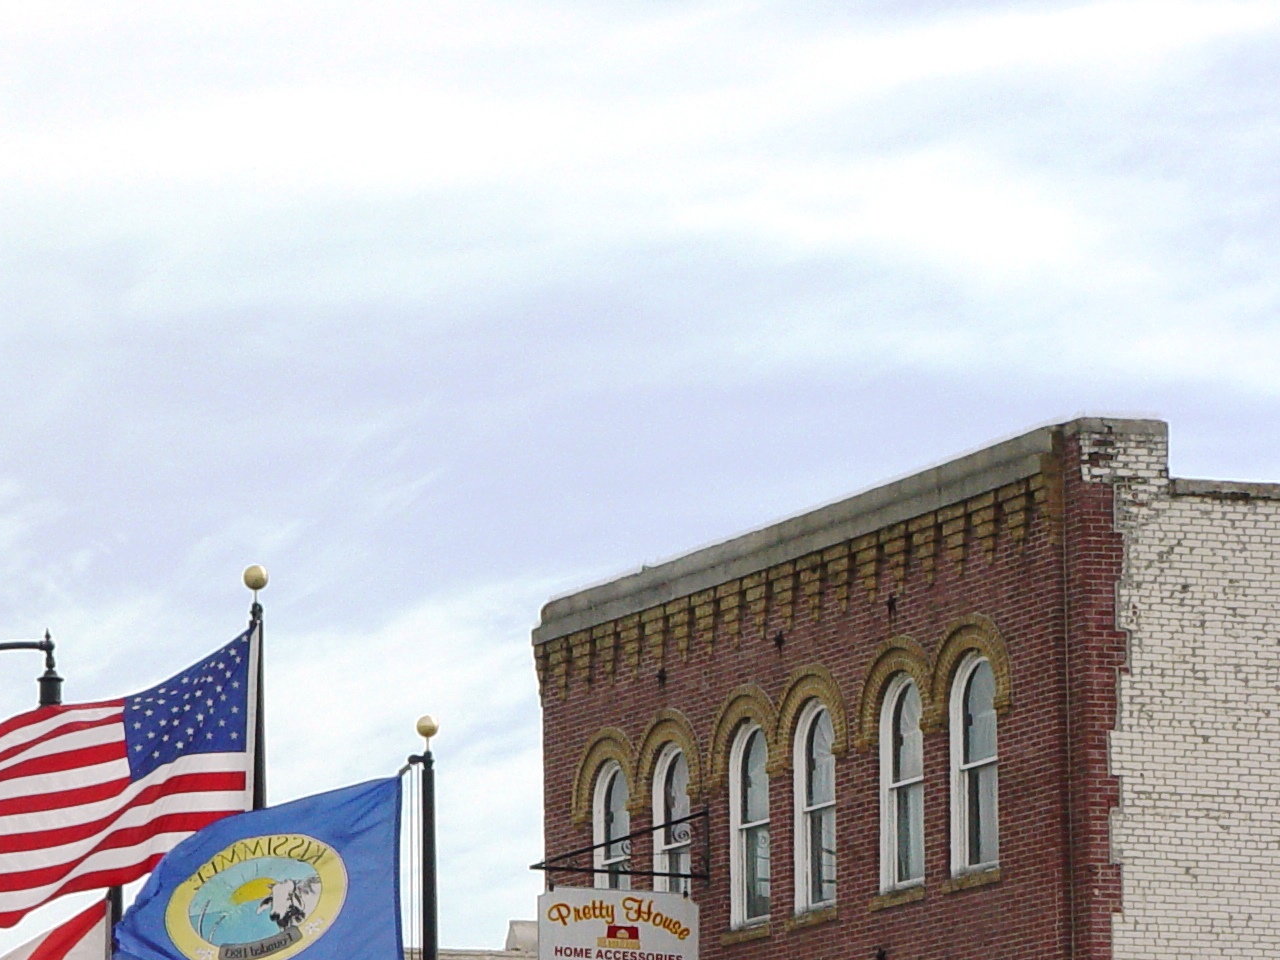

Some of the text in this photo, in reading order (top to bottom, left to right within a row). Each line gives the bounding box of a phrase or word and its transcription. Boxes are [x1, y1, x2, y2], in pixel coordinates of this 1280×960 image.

[548, 897, 691, 940] Pretty House
[554, 946, 592, 960] HOME
